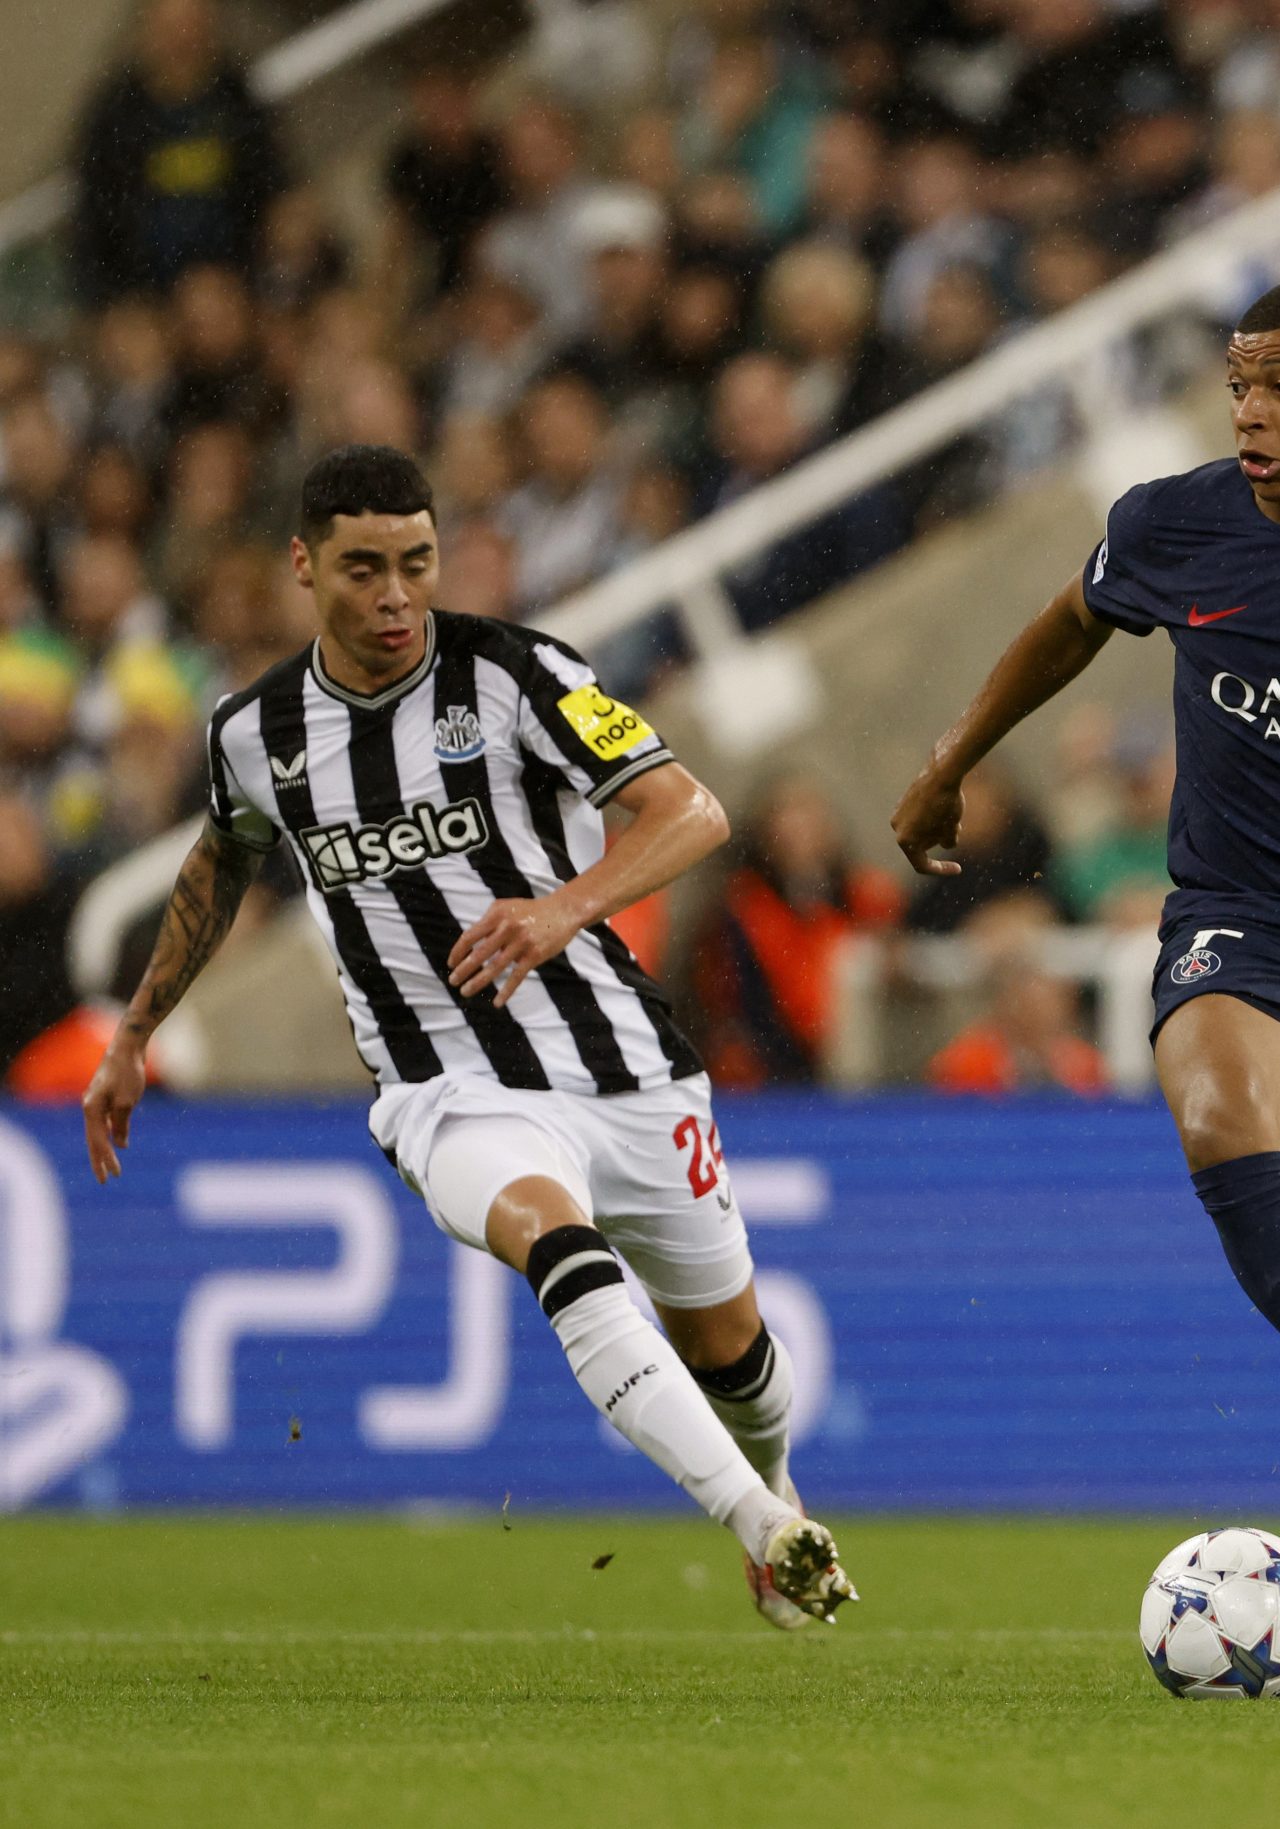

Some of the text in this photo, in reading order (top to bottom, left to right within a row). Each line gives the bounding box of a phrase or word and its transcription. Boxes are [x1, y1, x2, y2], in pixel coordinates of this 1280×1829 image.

[594, 715, 639, 751] noo
[354, 802, 485, 875] sela
[604, 1363, 660, 1412] NUFC
